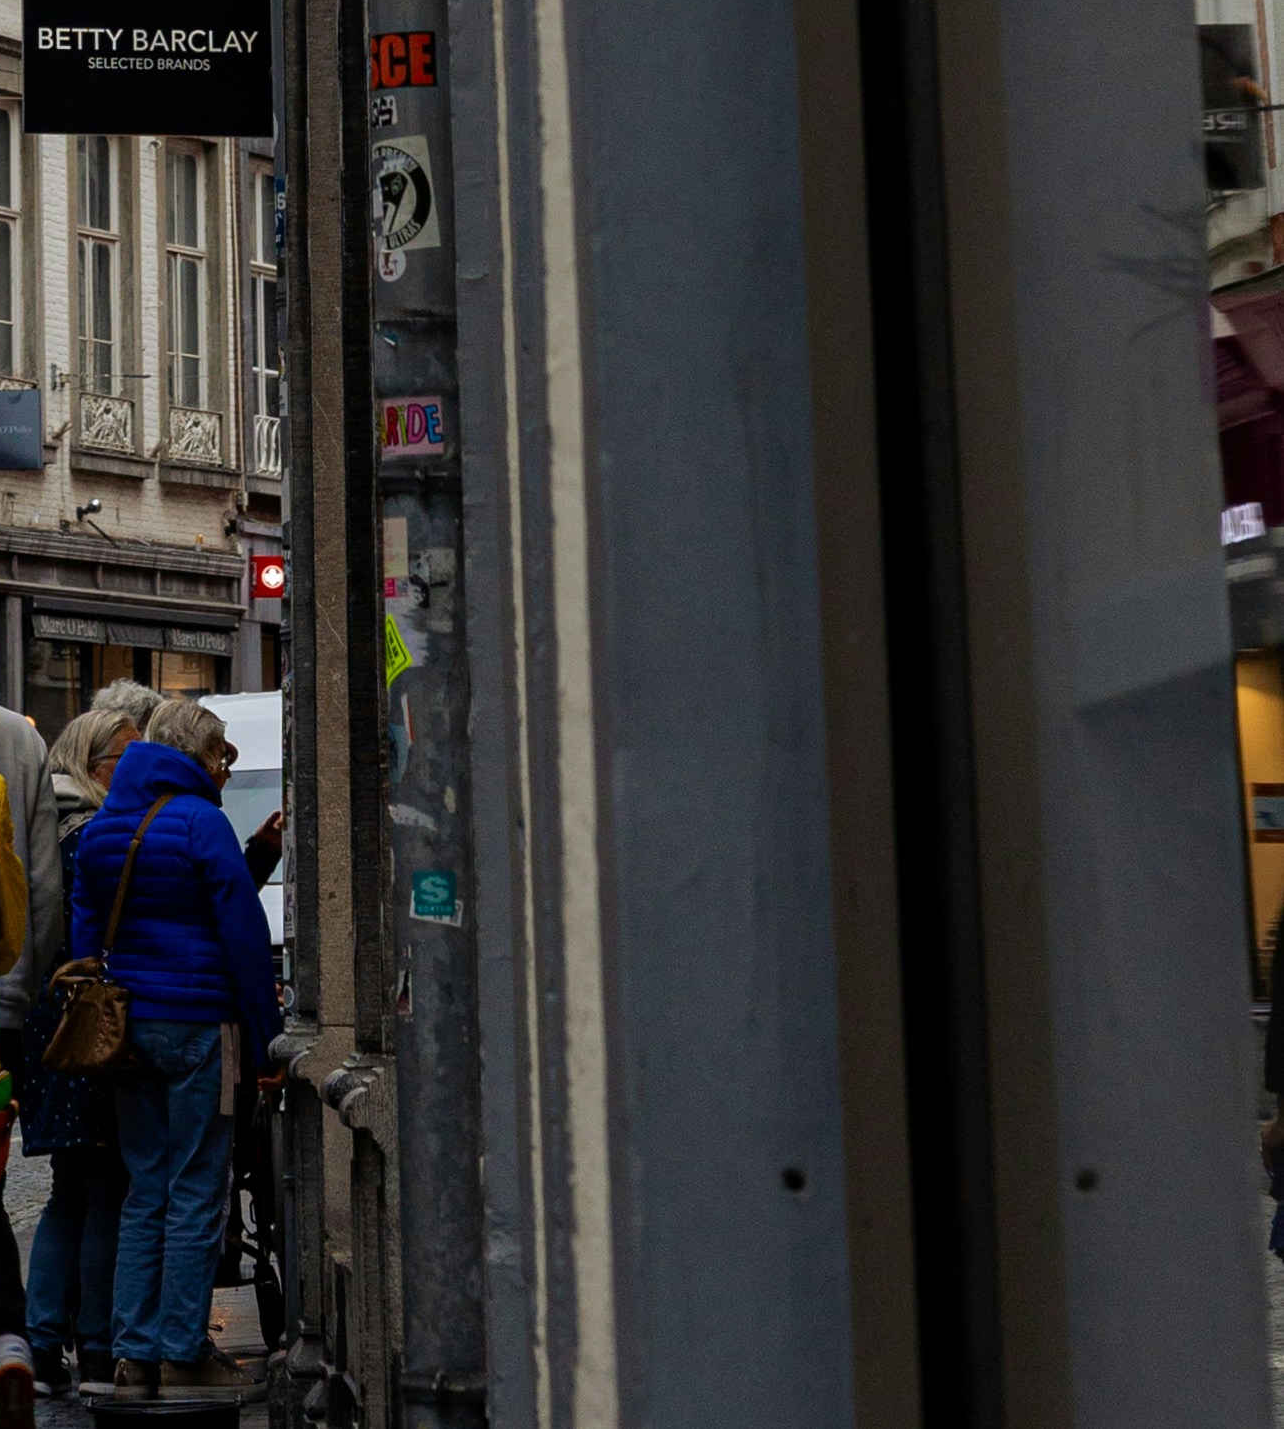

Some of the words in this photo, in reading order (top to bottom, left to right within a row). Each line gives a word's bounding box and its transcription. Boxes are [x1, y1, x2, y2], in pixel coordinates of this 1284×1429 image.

[37, 27, 124, 53] BETTY
[132, 28, 259, 55] BARCLAY
[87, 56, 153, 71] SELECTED
[156, 57, 212, 73] BRANDS
[40, 615, 66, 635] Marc
